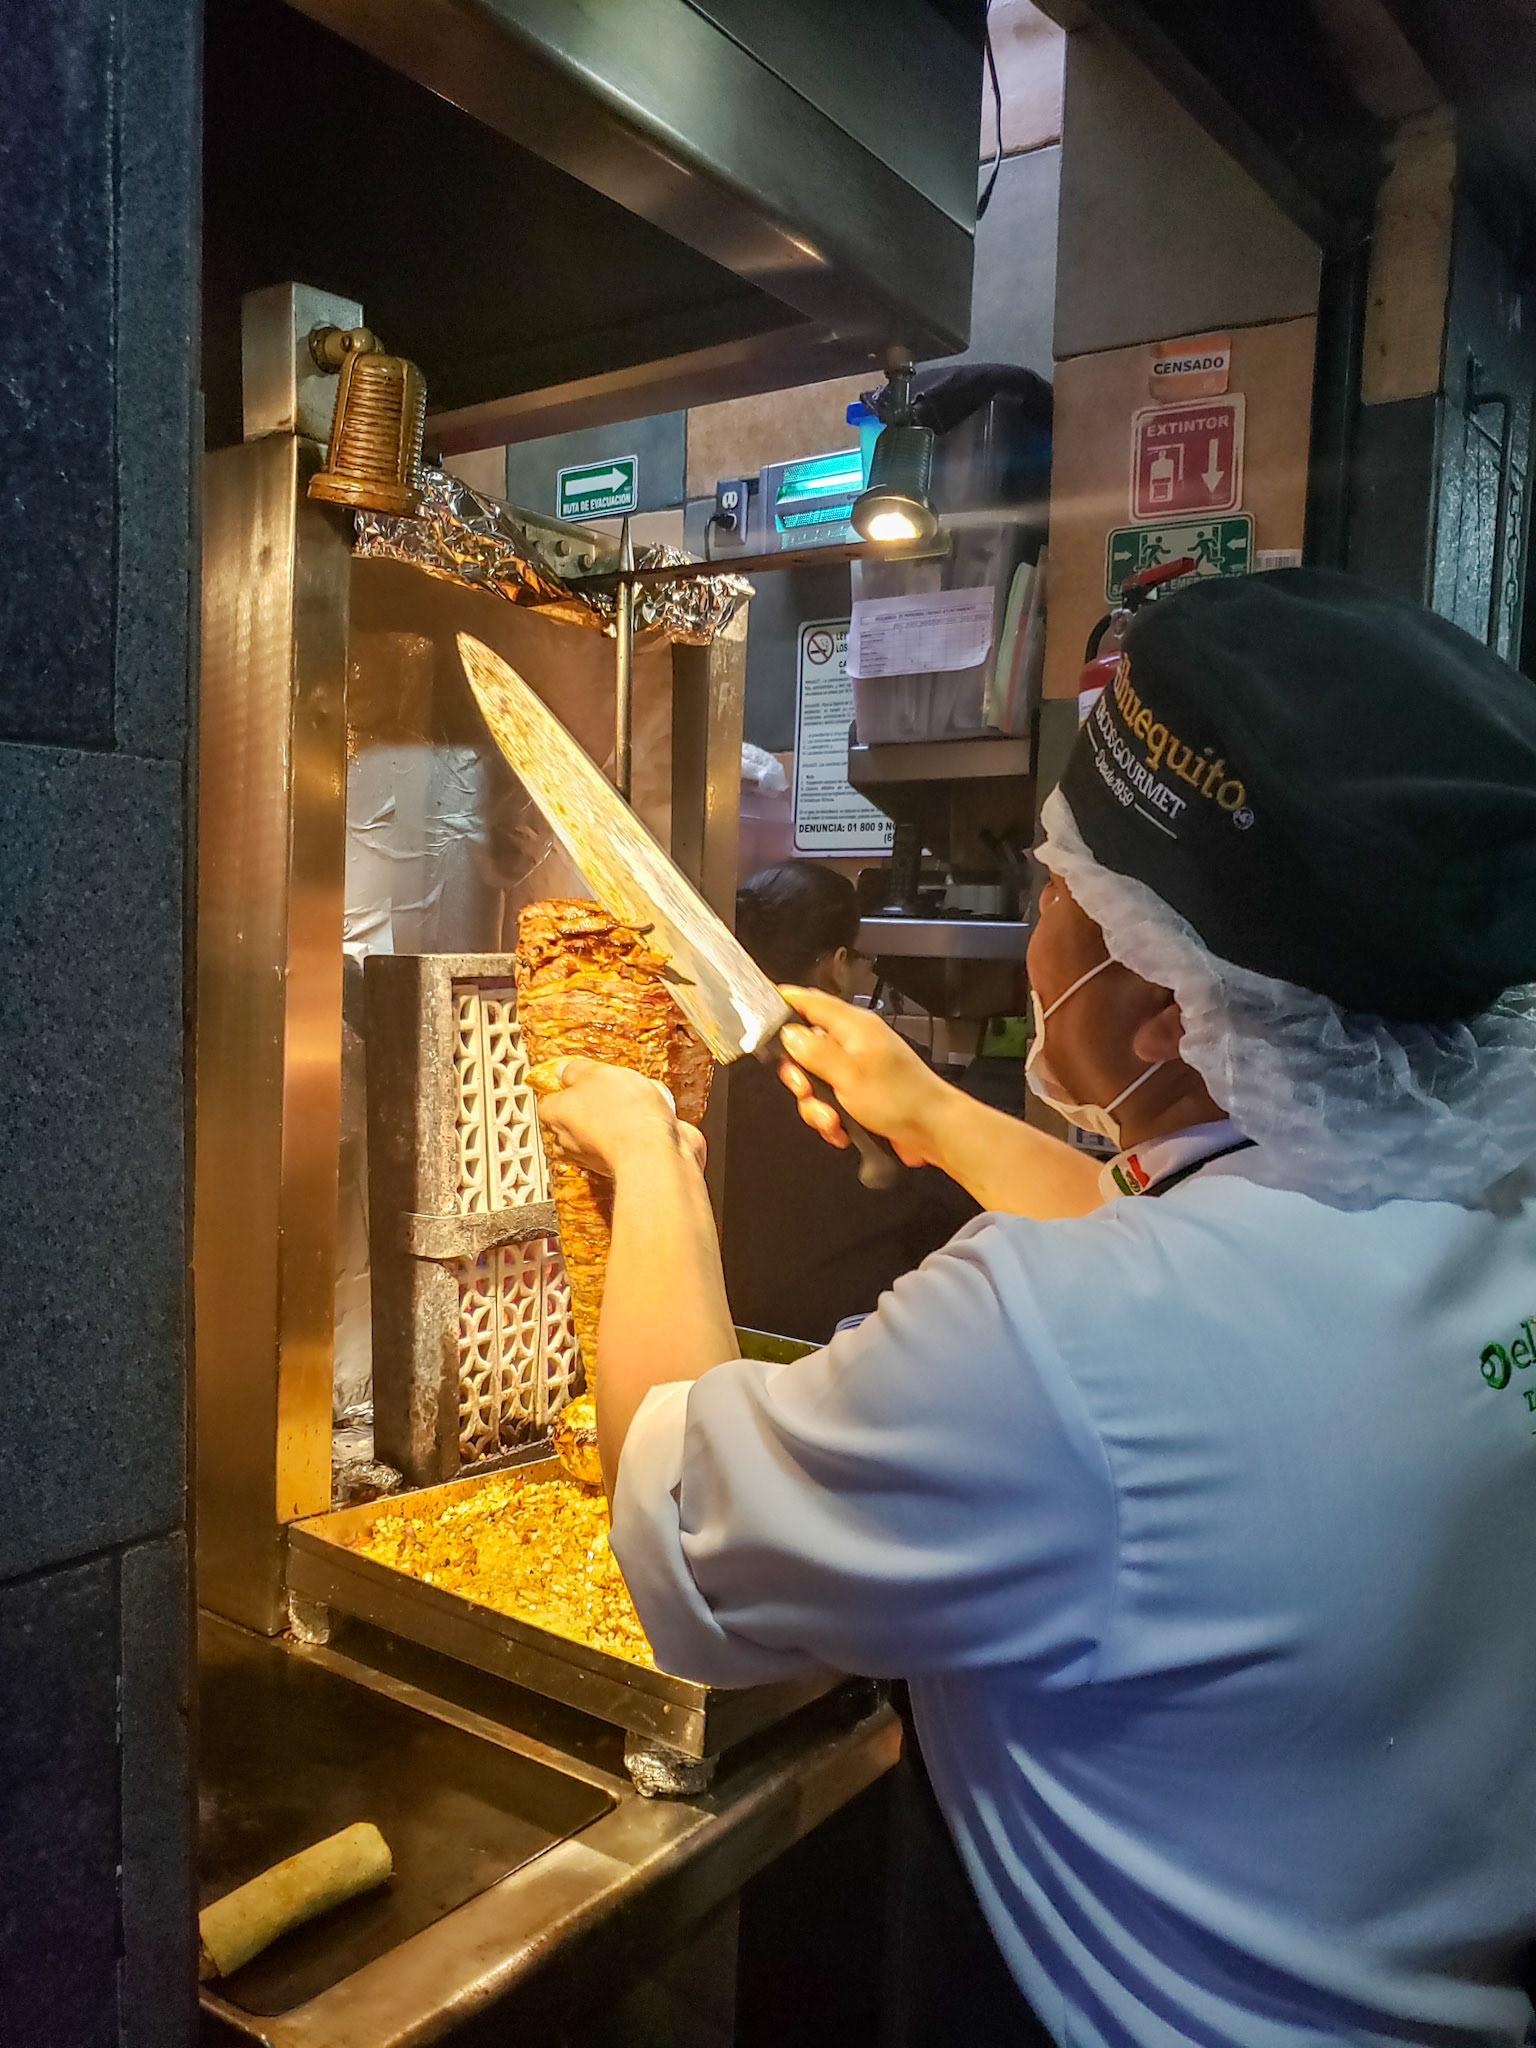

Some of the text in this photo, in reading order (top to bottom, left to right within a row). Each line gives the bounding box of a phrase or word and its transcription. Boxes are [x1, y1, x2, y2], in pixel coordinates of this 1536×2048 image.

[1153, 356, 1225, 375] CENSADO
[1146, 415, 1230, 437] EXTINTOR
[562, 502, 580, 515] RUTA
[799, 823, 845, 833] DENUNCIA:
[847, 823, 857, 832] 01
[860, 822, 875, 832] 800
[877, 822, 883, 831] 9
